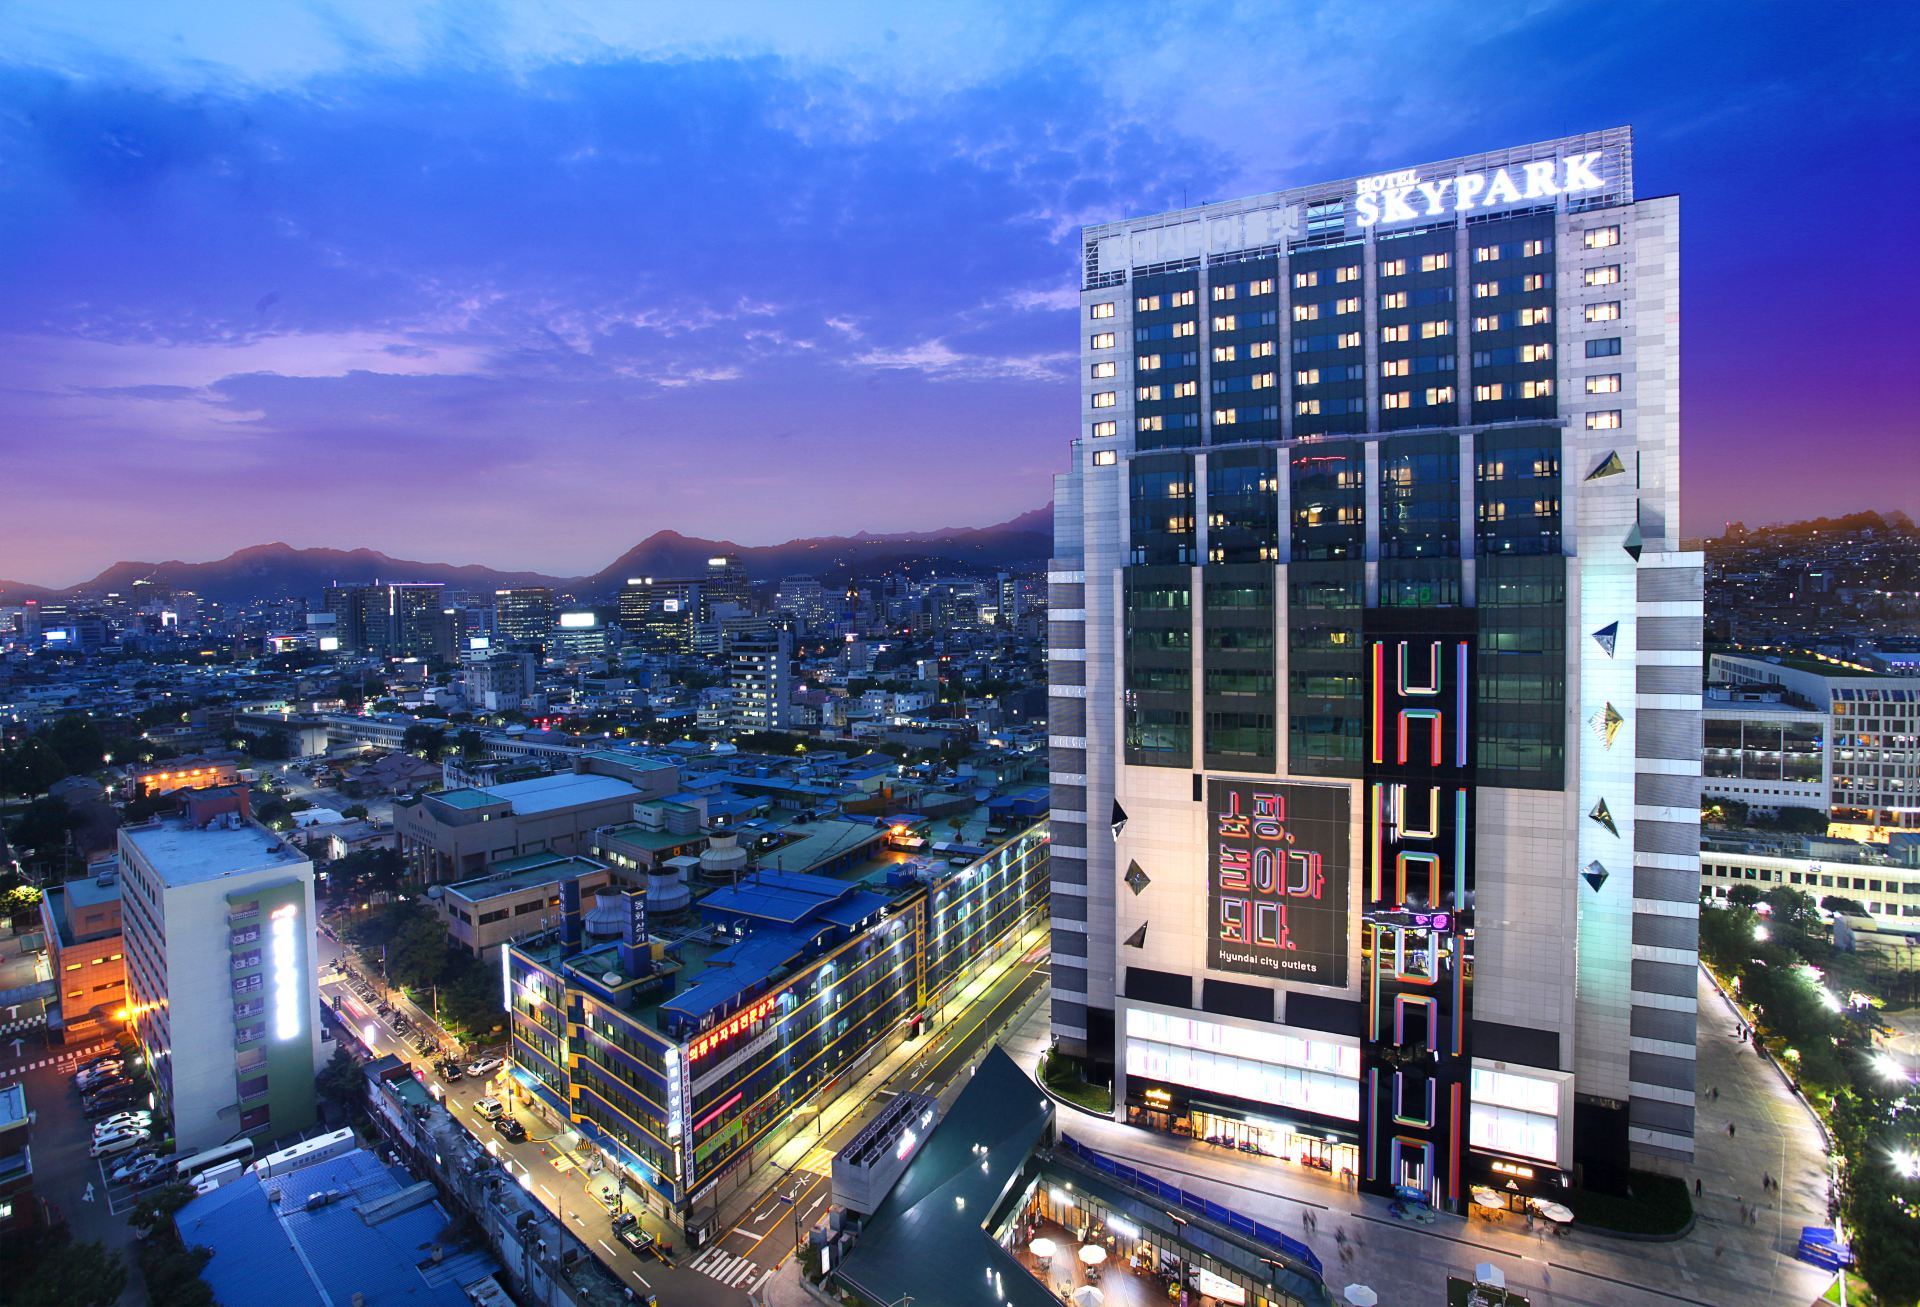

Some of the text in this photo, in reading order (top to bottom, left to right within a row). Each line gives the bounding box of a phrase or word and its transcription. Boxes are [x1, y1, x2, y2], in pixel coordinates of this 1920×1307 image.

[1355, 151, 1606, 227] SKYPARK
[1356, 169, 1421, 195] HOTEL
[634, 900, 645, 942] 동화상가
[1219, 950, 1318, 973] Hyundai city outlets
